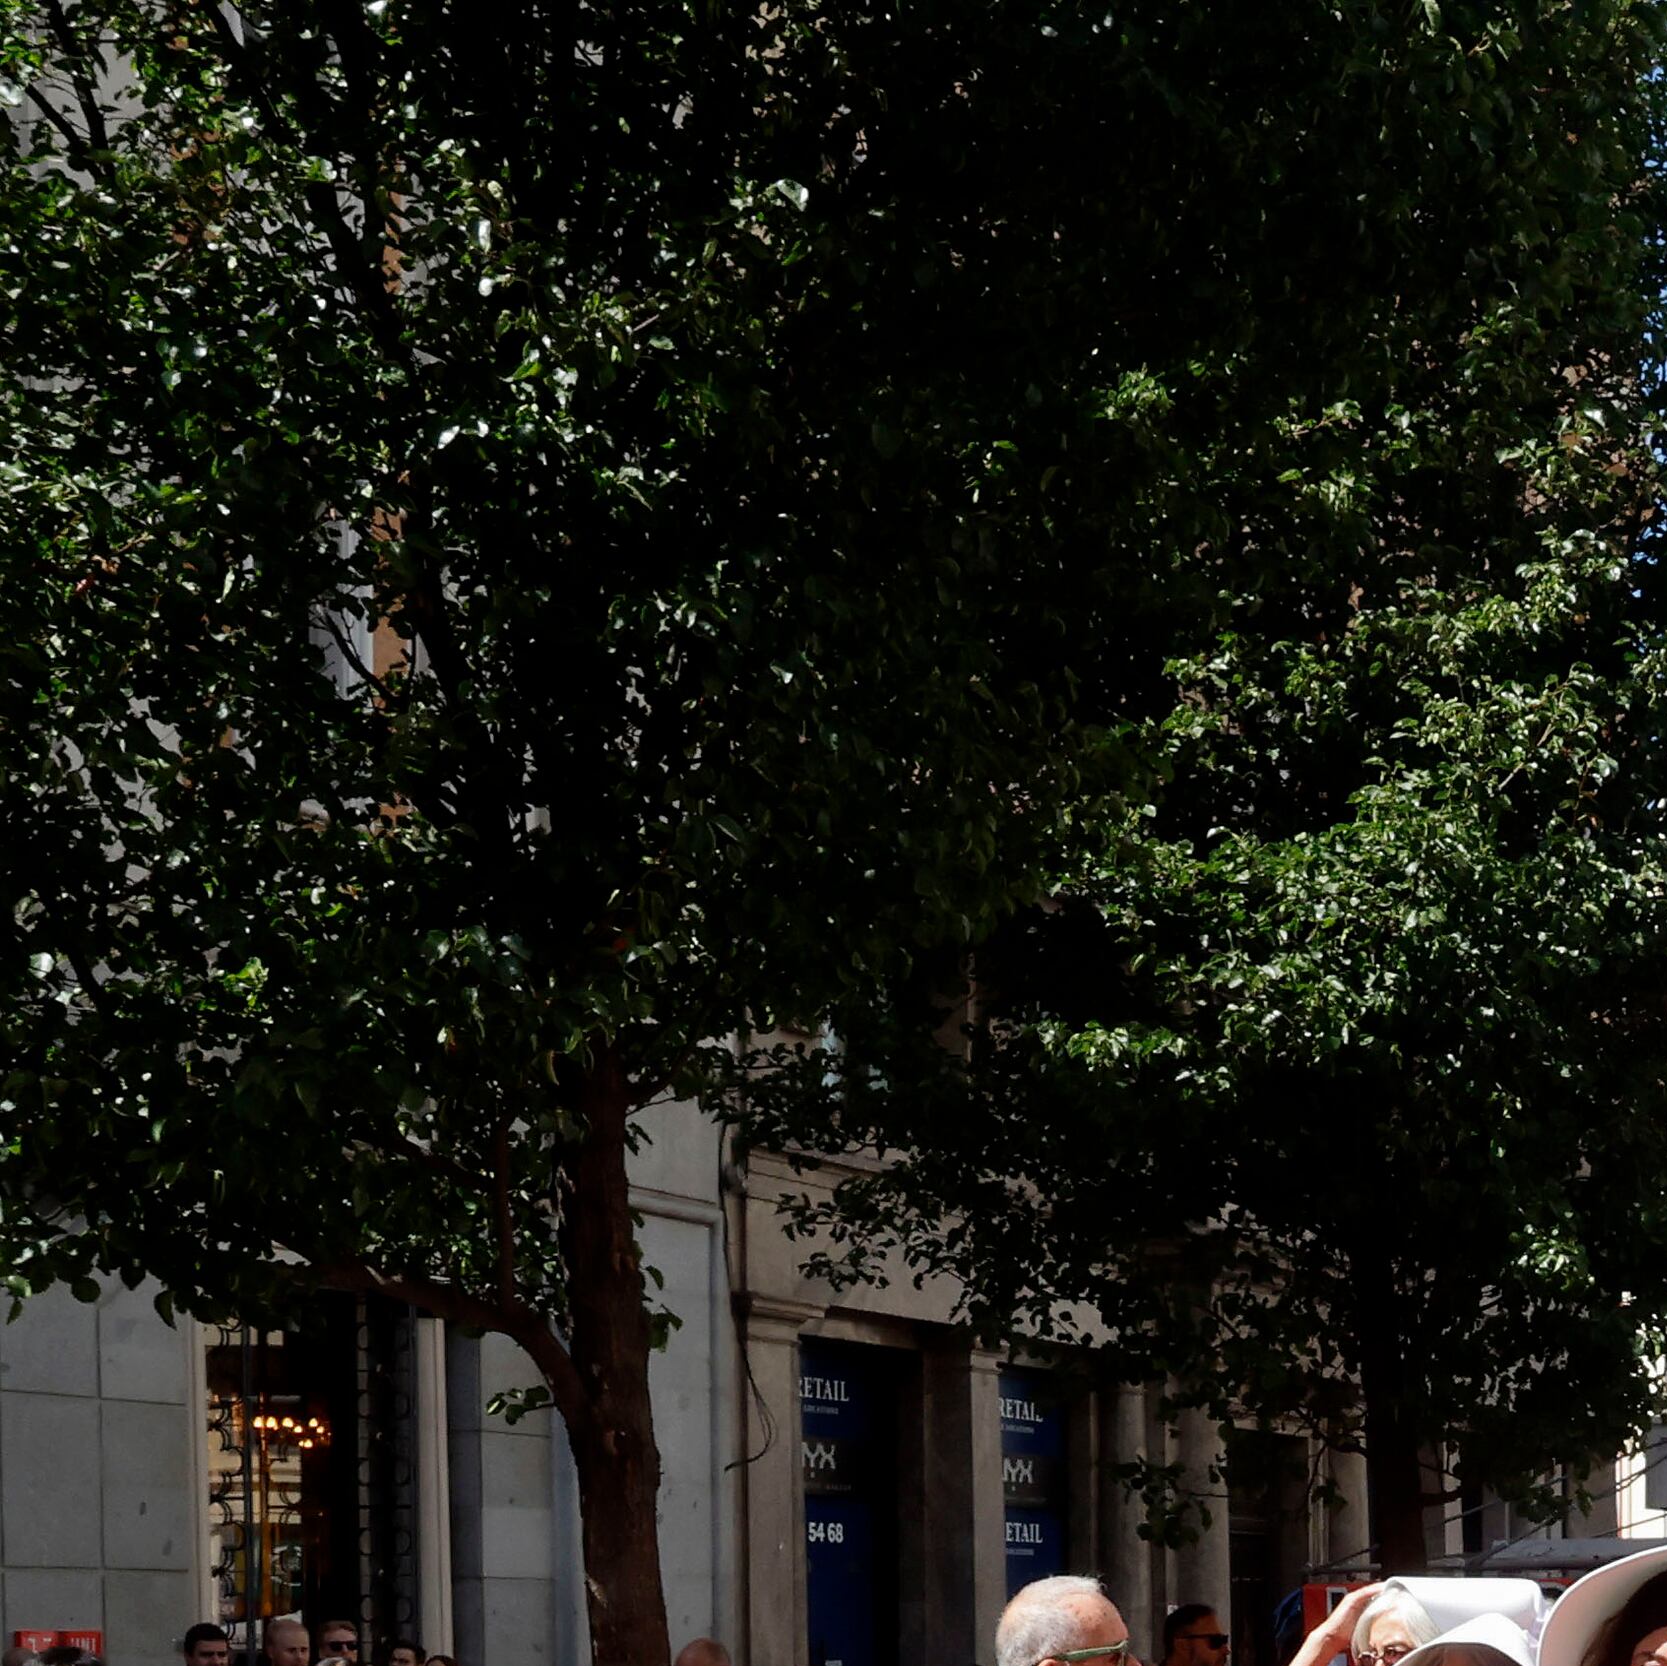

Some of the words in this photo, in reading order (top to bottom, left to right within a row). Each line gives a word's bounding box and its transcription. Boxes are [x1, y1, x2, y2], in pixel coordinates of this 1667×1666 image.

[808, 1522, 826, 1543] 54
[827, 1523, 845, 1544] 68
[1004, 1521, 1043, 1544] ETAIL
